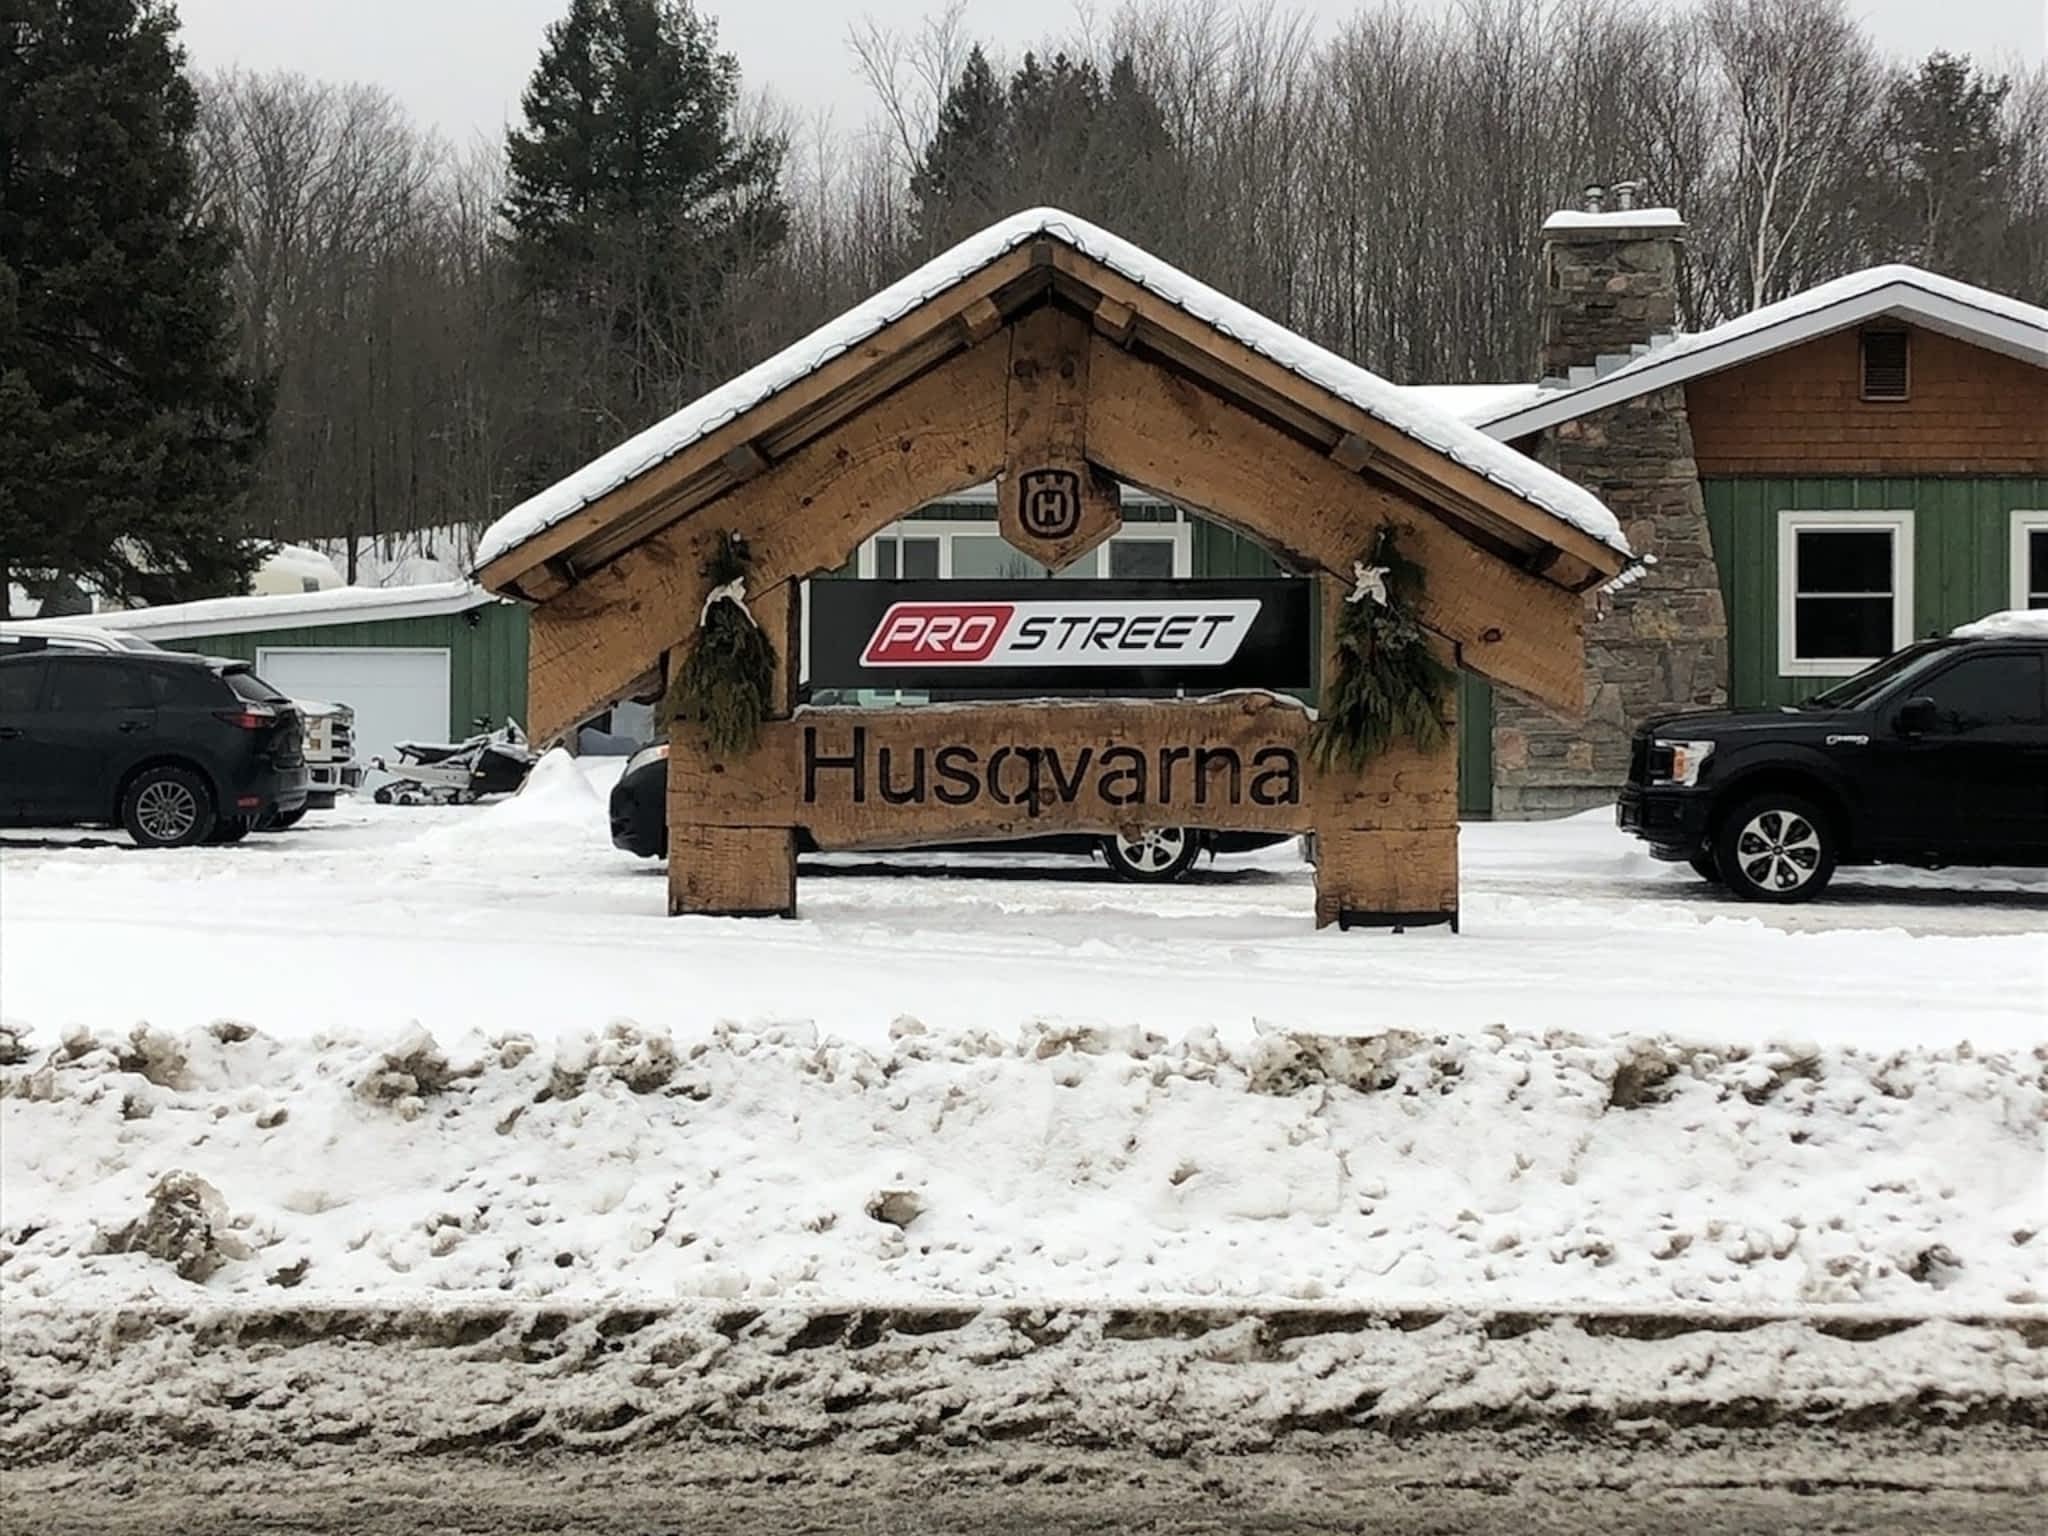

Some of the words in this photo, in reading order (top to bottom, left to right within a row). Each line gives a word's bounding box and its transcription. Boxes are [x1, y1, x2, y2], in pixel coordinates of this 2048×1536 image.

[878, 615, 997, 652] PRO
[1008, 615, 1235, 650] STREET
[803, 725, 1300, 817] Husqvarna
